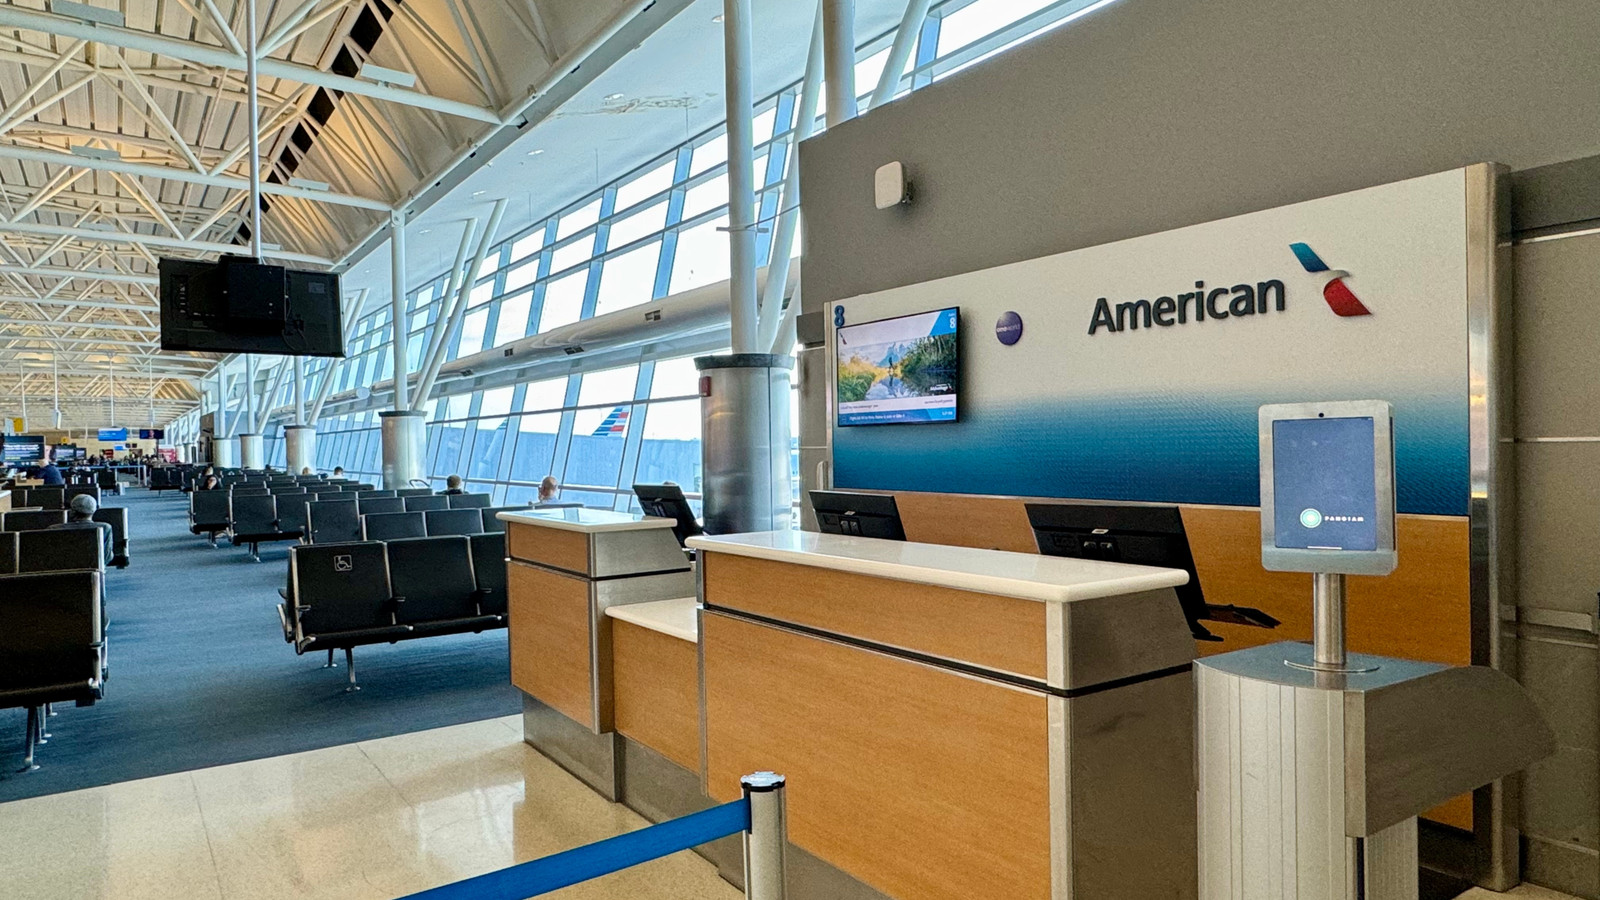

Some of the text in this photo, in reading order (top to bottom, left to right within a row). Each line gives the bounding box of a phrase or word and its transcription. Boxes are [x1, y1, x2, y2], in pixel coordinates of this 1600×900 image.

[834, 305, 845, 328] 8
[1088, 279, 1285, 335] American
[949, 317, 956, 329] 8
